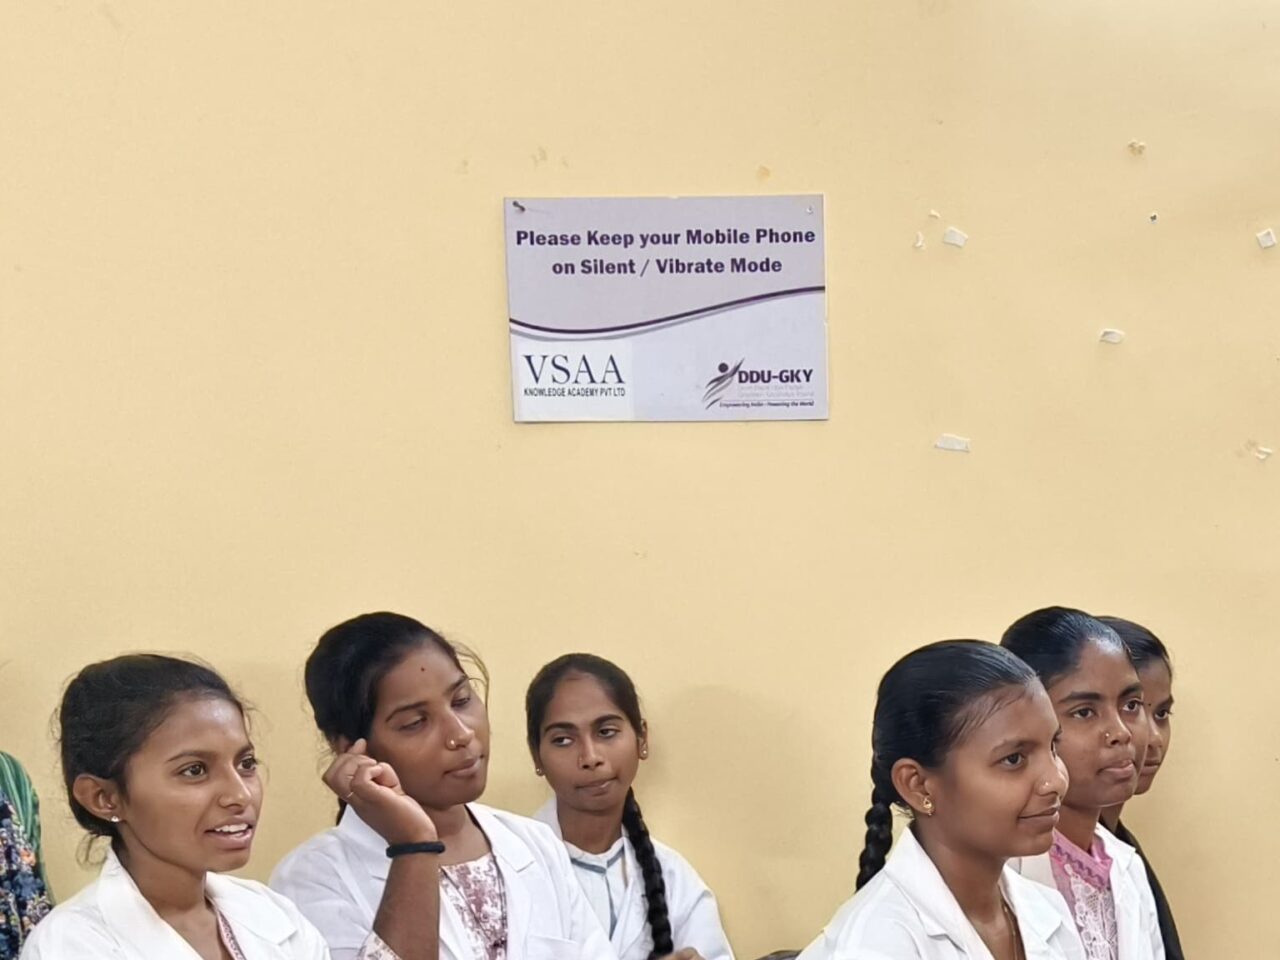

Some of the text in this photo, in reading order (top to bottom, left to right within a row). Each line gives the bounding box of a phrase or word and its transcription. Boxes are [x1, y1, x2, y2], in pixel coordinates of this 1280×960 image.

[516, 228, 816, 249] Please Keep your Mobile Phone
[552, 257, 783, 278] on Silent / Vibrate Mode
[523, 354, 625, 384] VSAA
[738, 369, 813, 383] DDU-GKY
[523, 387, 626, 398] KNOWLEDGE ACADEMY PVT LTD
